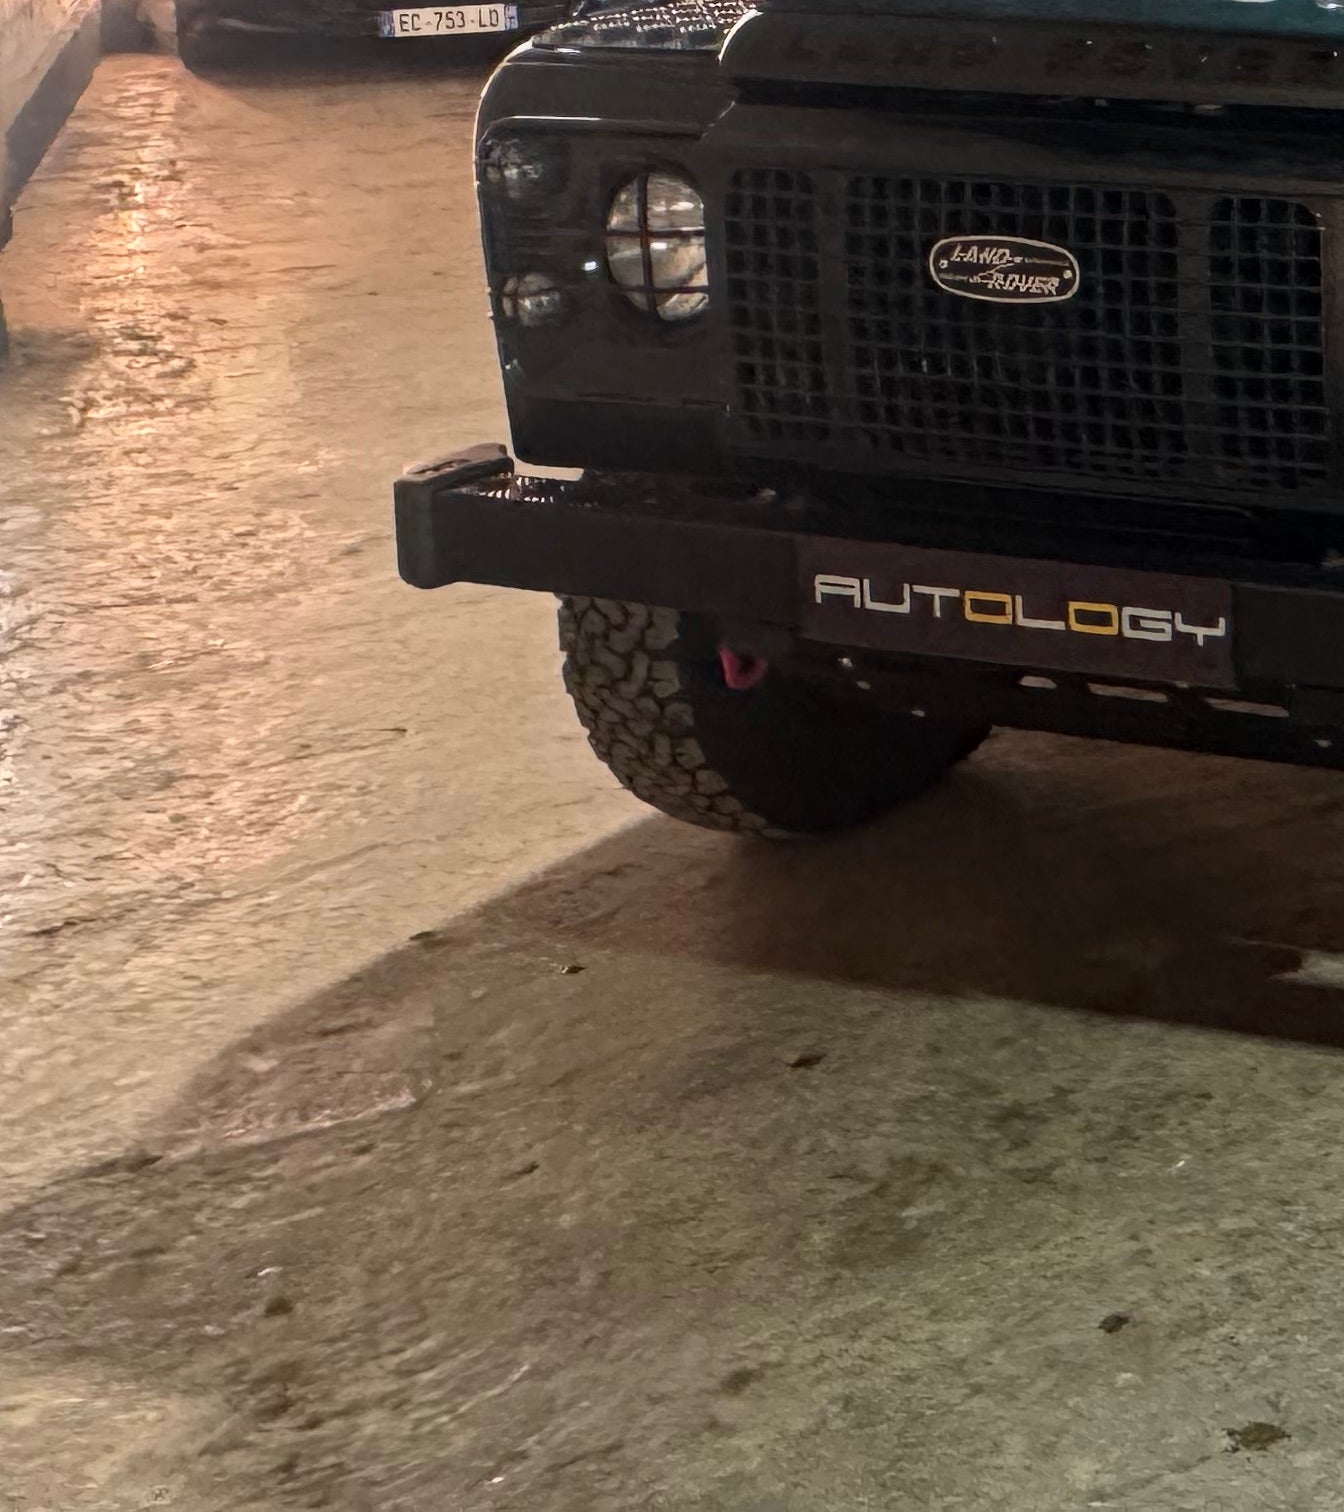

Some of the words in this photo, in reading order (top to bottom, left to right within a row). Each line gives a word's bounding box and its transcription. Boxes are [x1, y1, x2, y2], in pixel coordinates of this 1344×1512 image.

[399, 8, 500, 32] EC-753-LD
[950, 244, 1012, 265] LAND
[987, 272, 1061, 296] ROVER
[814, 573, 1226, 647] AUTOLOGY
